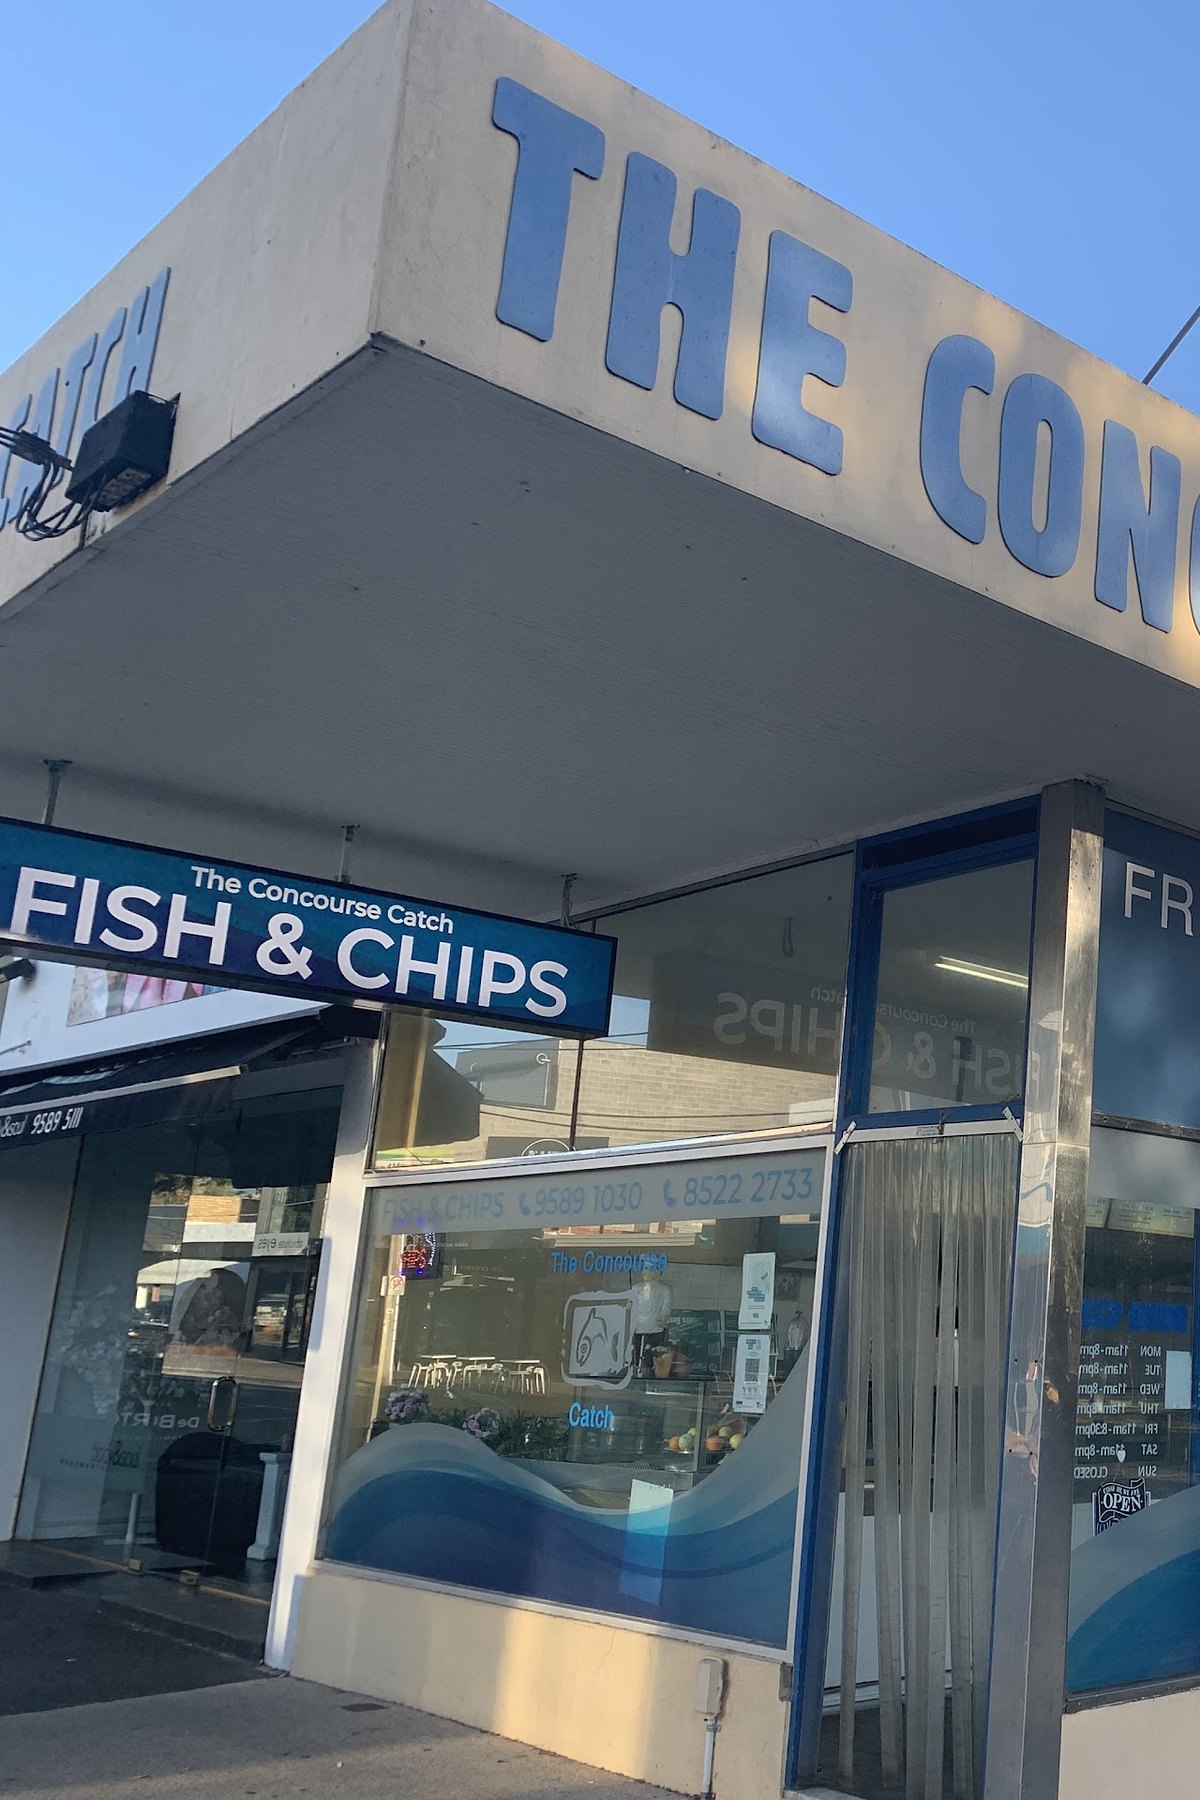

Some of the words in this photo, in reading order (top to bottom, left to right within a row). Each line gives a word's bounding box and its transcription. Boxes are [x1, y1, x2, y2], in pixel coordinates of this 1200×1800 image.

[491, 76, 853, 476] THE
[191, 866, 242, 894] The
[248, 877, 382, 920] Concourse
[387, 905, 454, 934] Catch
[9, 866, 232, 966] FISH
[256, 912, 313, 980] &
[337, 928, 570, 1018] CHIPS
[31, 1110, 62, 1135] 9589
[383, 1198, 421, 1223] FISH
[445, 1190, 504, 1220] CHIPS
[535, 1187, 585, 1216] 9589
[593, 1182, 643, 1213] 1030
[684, 1173, 742, 1206] 8522
[752, 1168, 813, 1202] 2733
[551, 1252, 578, 1274] The
[583, 1250, 669, 1274] Concourse
[569, 1402, 615, 1429] Catch
[1103, 1492, 1142, 1512] OPEN
